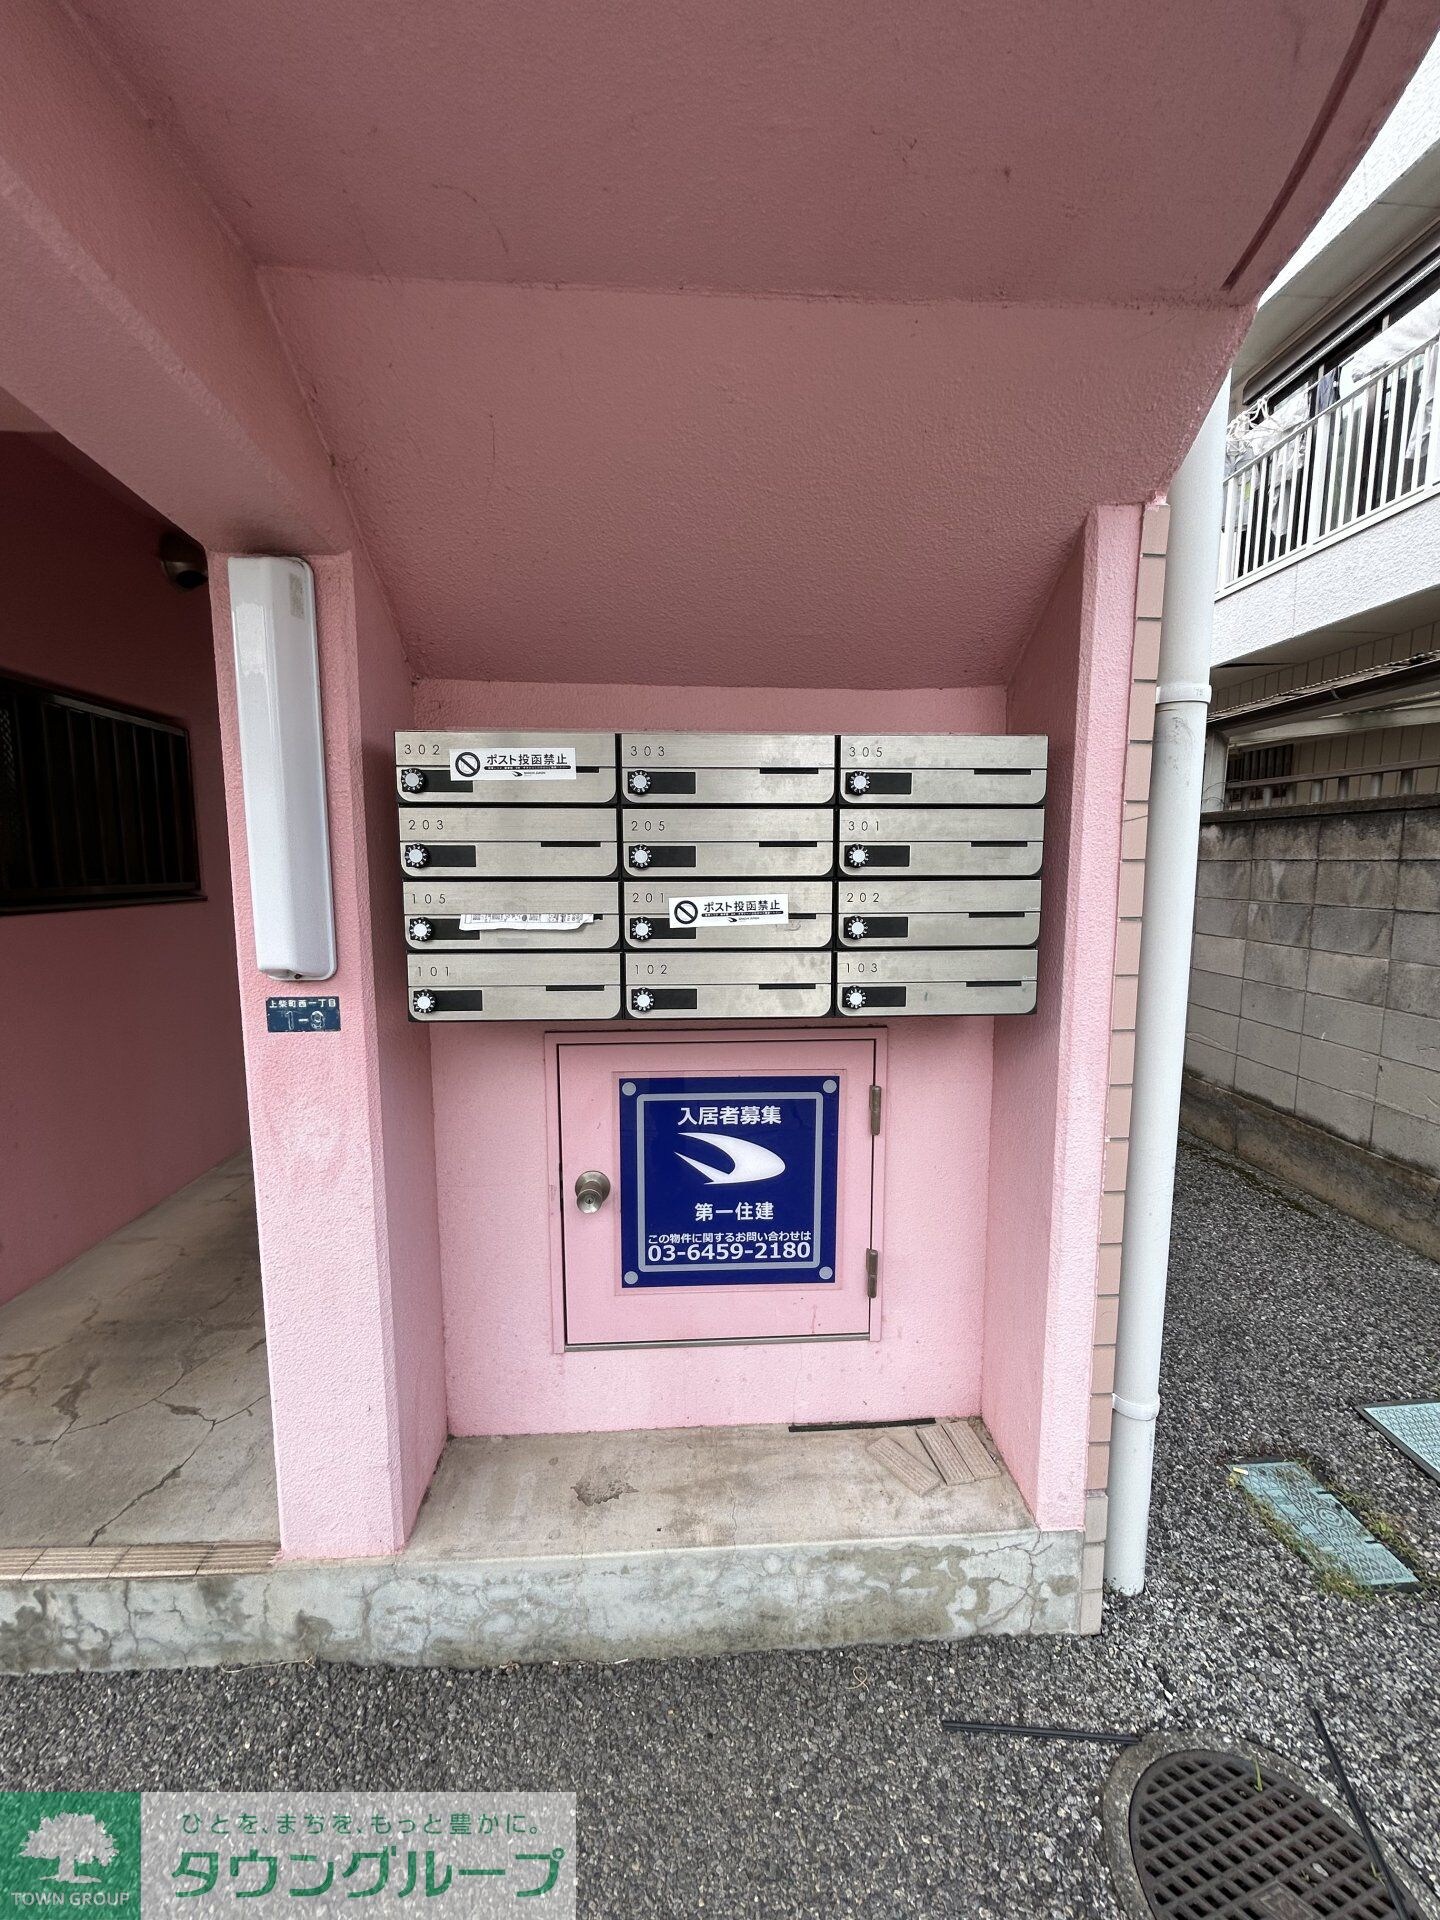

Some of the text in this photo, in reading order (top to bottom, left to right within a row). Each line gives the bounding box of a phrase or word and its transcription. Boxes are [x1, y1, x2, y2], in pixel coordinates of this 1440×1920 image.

[404, 744, 440, 755] 302
[630, 745, 666, 757] 303
[848, 746, 883, 758] 305
[486, 753, 568, 765] ポスト投函禁止
[408, 819, 444, 830] 203
[631, 820, 666, 831] 205
[848, 821, 880, 832] 301
[411, 893, 446, 905] 105
[632, 892, 665, 903] 201
[846, 892, 880, 903] 202
[703, 899, 781, 912] ポスト投函禁止
[417, 966, 450, 977] 101
[635, 964, 668, 975] 102
[845, 962, 878, 973] 103
[677, 1106, 782, 1126] 入居者募集
[694, 1202, 774, 1222] 第一住建
[648, 1231, 812, 1244] この物件に関するお問い合わせは
[648, 1242, 811, 1262] 03-6459-2180
